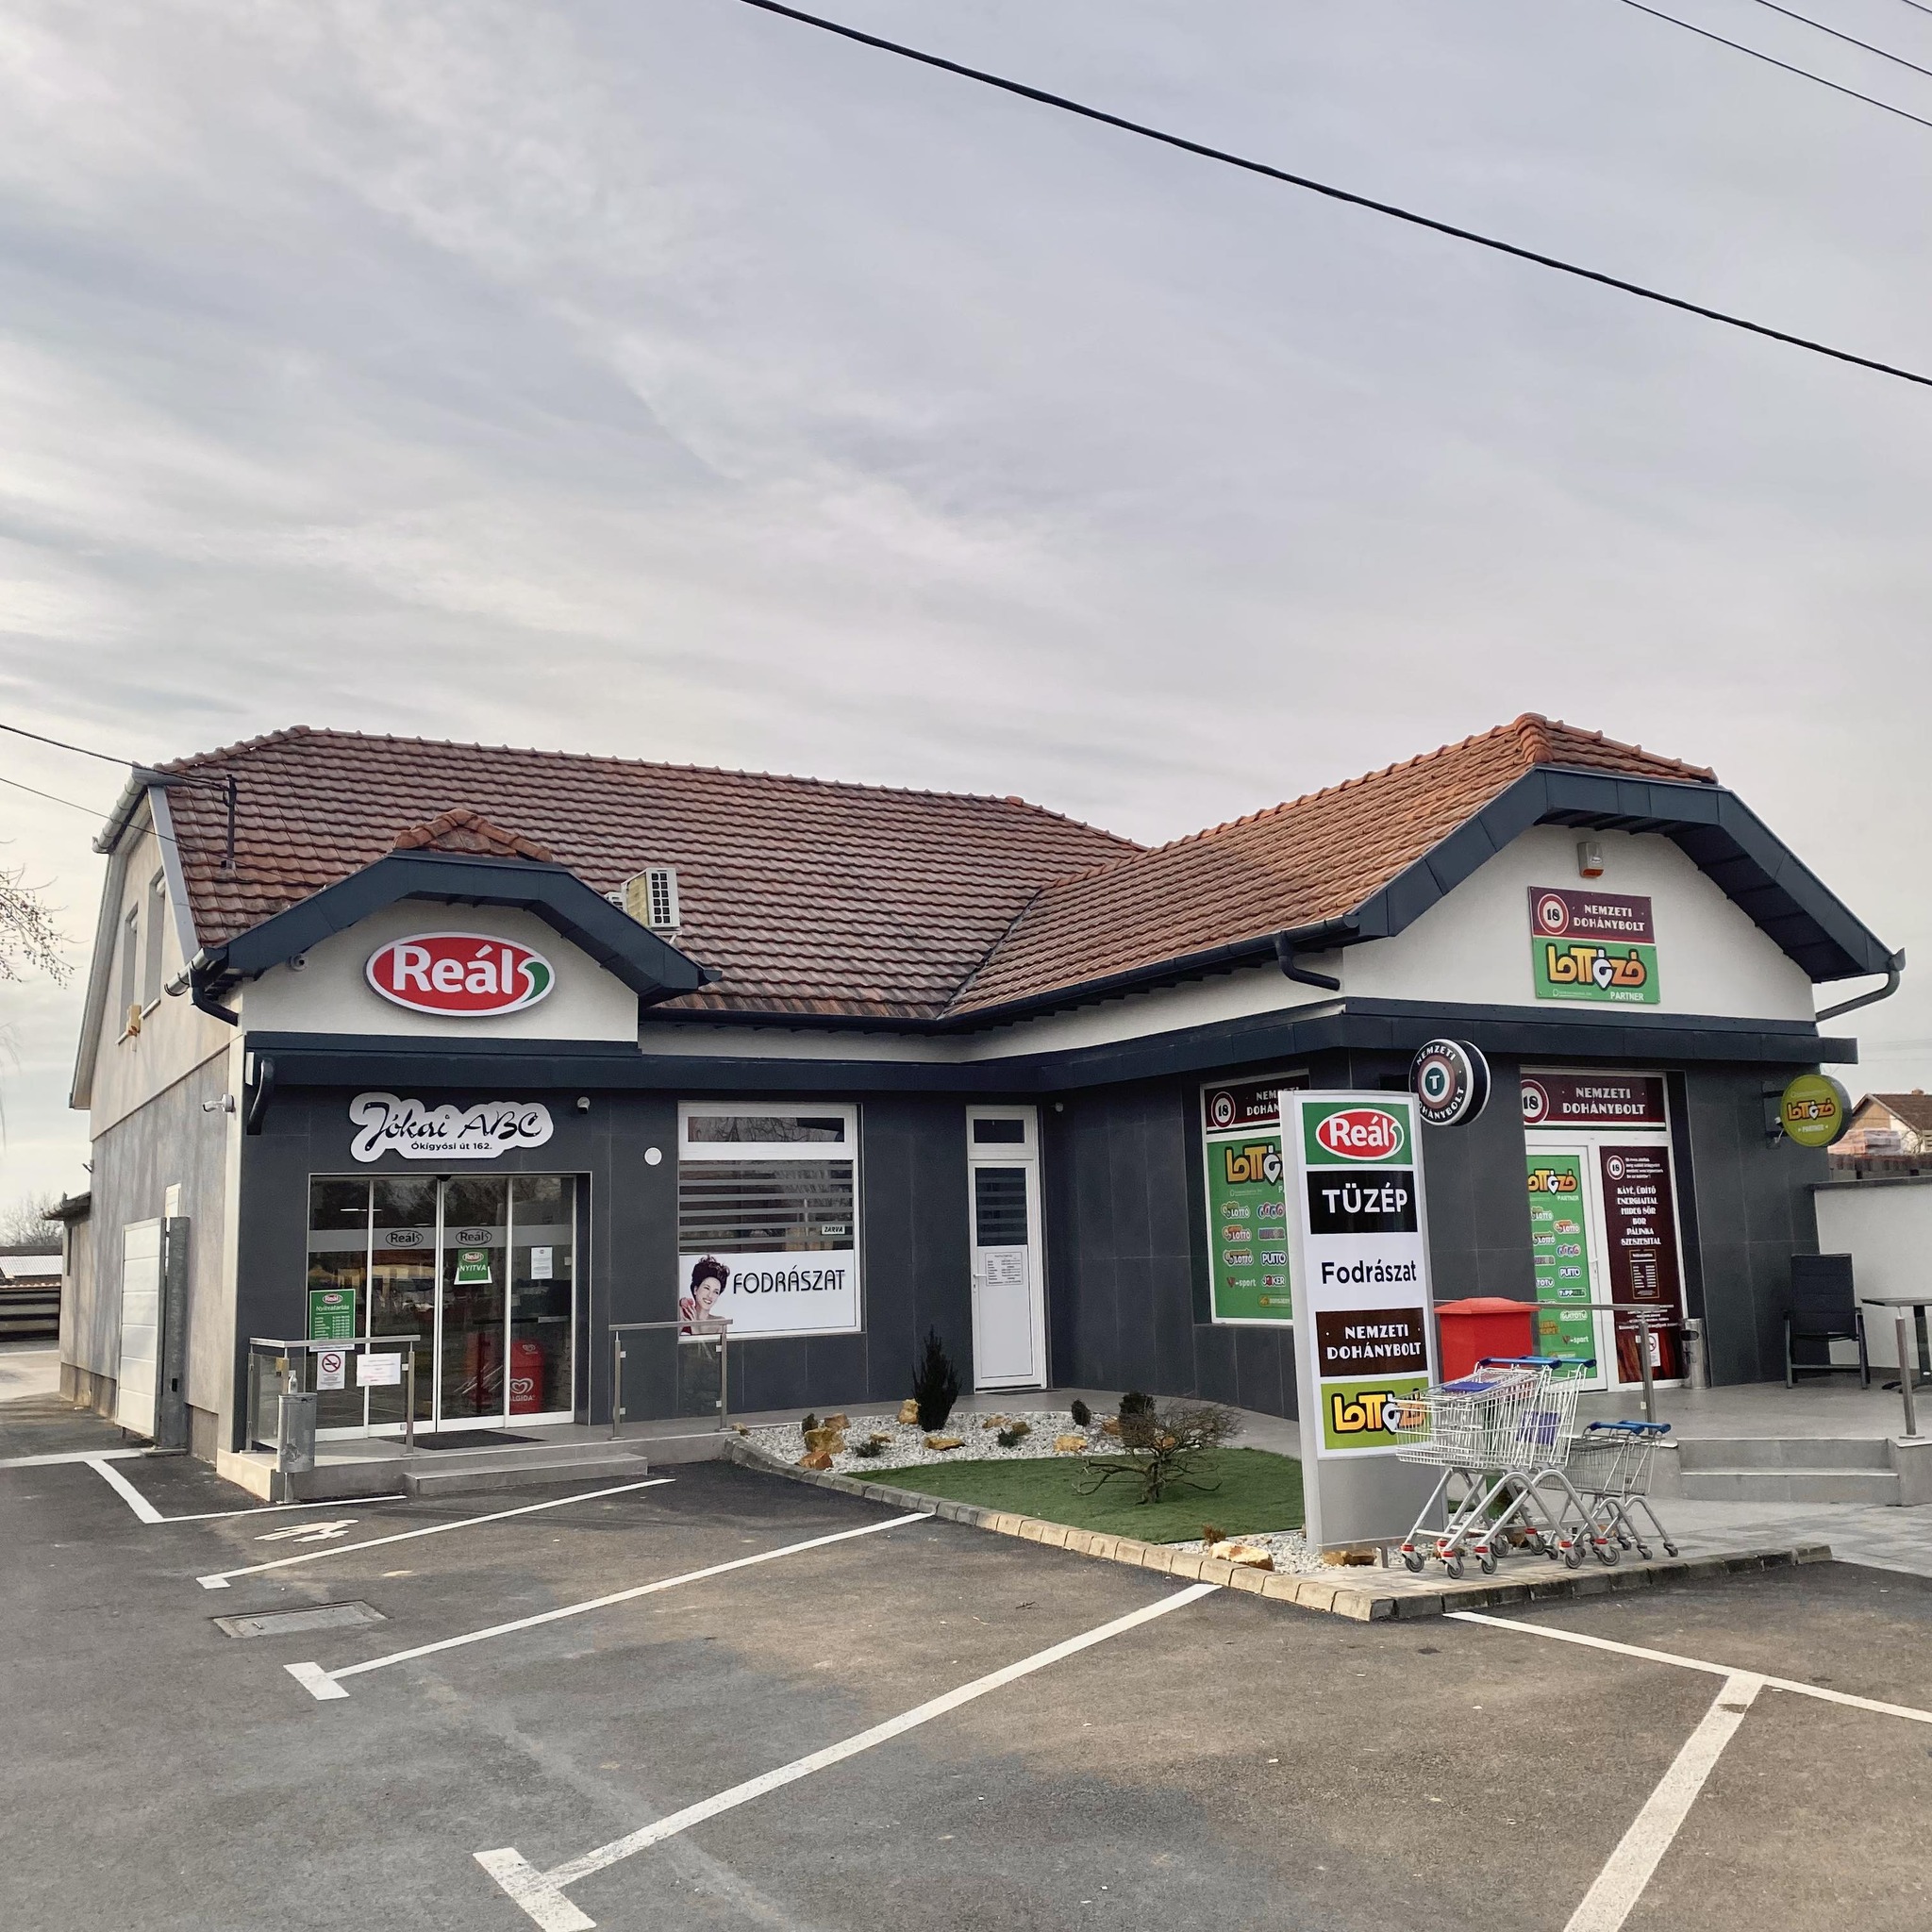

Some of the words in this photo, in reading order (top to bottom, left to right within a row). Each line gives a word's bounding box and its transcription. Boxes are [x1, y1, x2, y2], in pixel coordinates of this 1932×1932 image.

[1547, 908, 1560, 922] 18
[1584, 904, 1632, 917] NEMZETI
[1574, 916, 1645, 932] DOHÁNYBOLT
[392, 944, 513, 994] Reál
[1610, 991, 1644, 1001] PARTNER
[1416, 1044, 1457, 1066] NEMZETI
[1429, 1075, 1441, 1090] T
[1575, 1087, 1631, 1099] NEMZETI
[1246, 1102, 1279, 1116] DOHÁN
[1418, 1086, 1464, 1120] OHÁNYBOLT
[1523, 1095, 1539, 1109] 18
[1562, 1101, 1646, 1114] DOHÁNYBOLT
[1218, 1105, 1229, 1117] 18
[363, 1101, 448, 1151] Jókai
[458, 1110, 541, 1140] ABC
[1328, 1115, 1390, 1147] Reál
[411, 1141, 457, 1151] Ókígyósi
[1322, 1182, 1407, 1214] TÜZÉP
[1632, 1217, 1646, 1225] BOR
[390, 1232, 415, 1243] Reál
[459, 1231, 484, 1241] Reál
[458, 1264, 487, 1273] NYITVA
[1321, 1258, 1416, 1284] Fodrászat
[733, 1264, 845, 1294] FODRÁSZAT
[1344, 1324, 1408, 1340] NEMZETI
[1326, 1341, 1421, 1360] DOHÁNYBOLT
